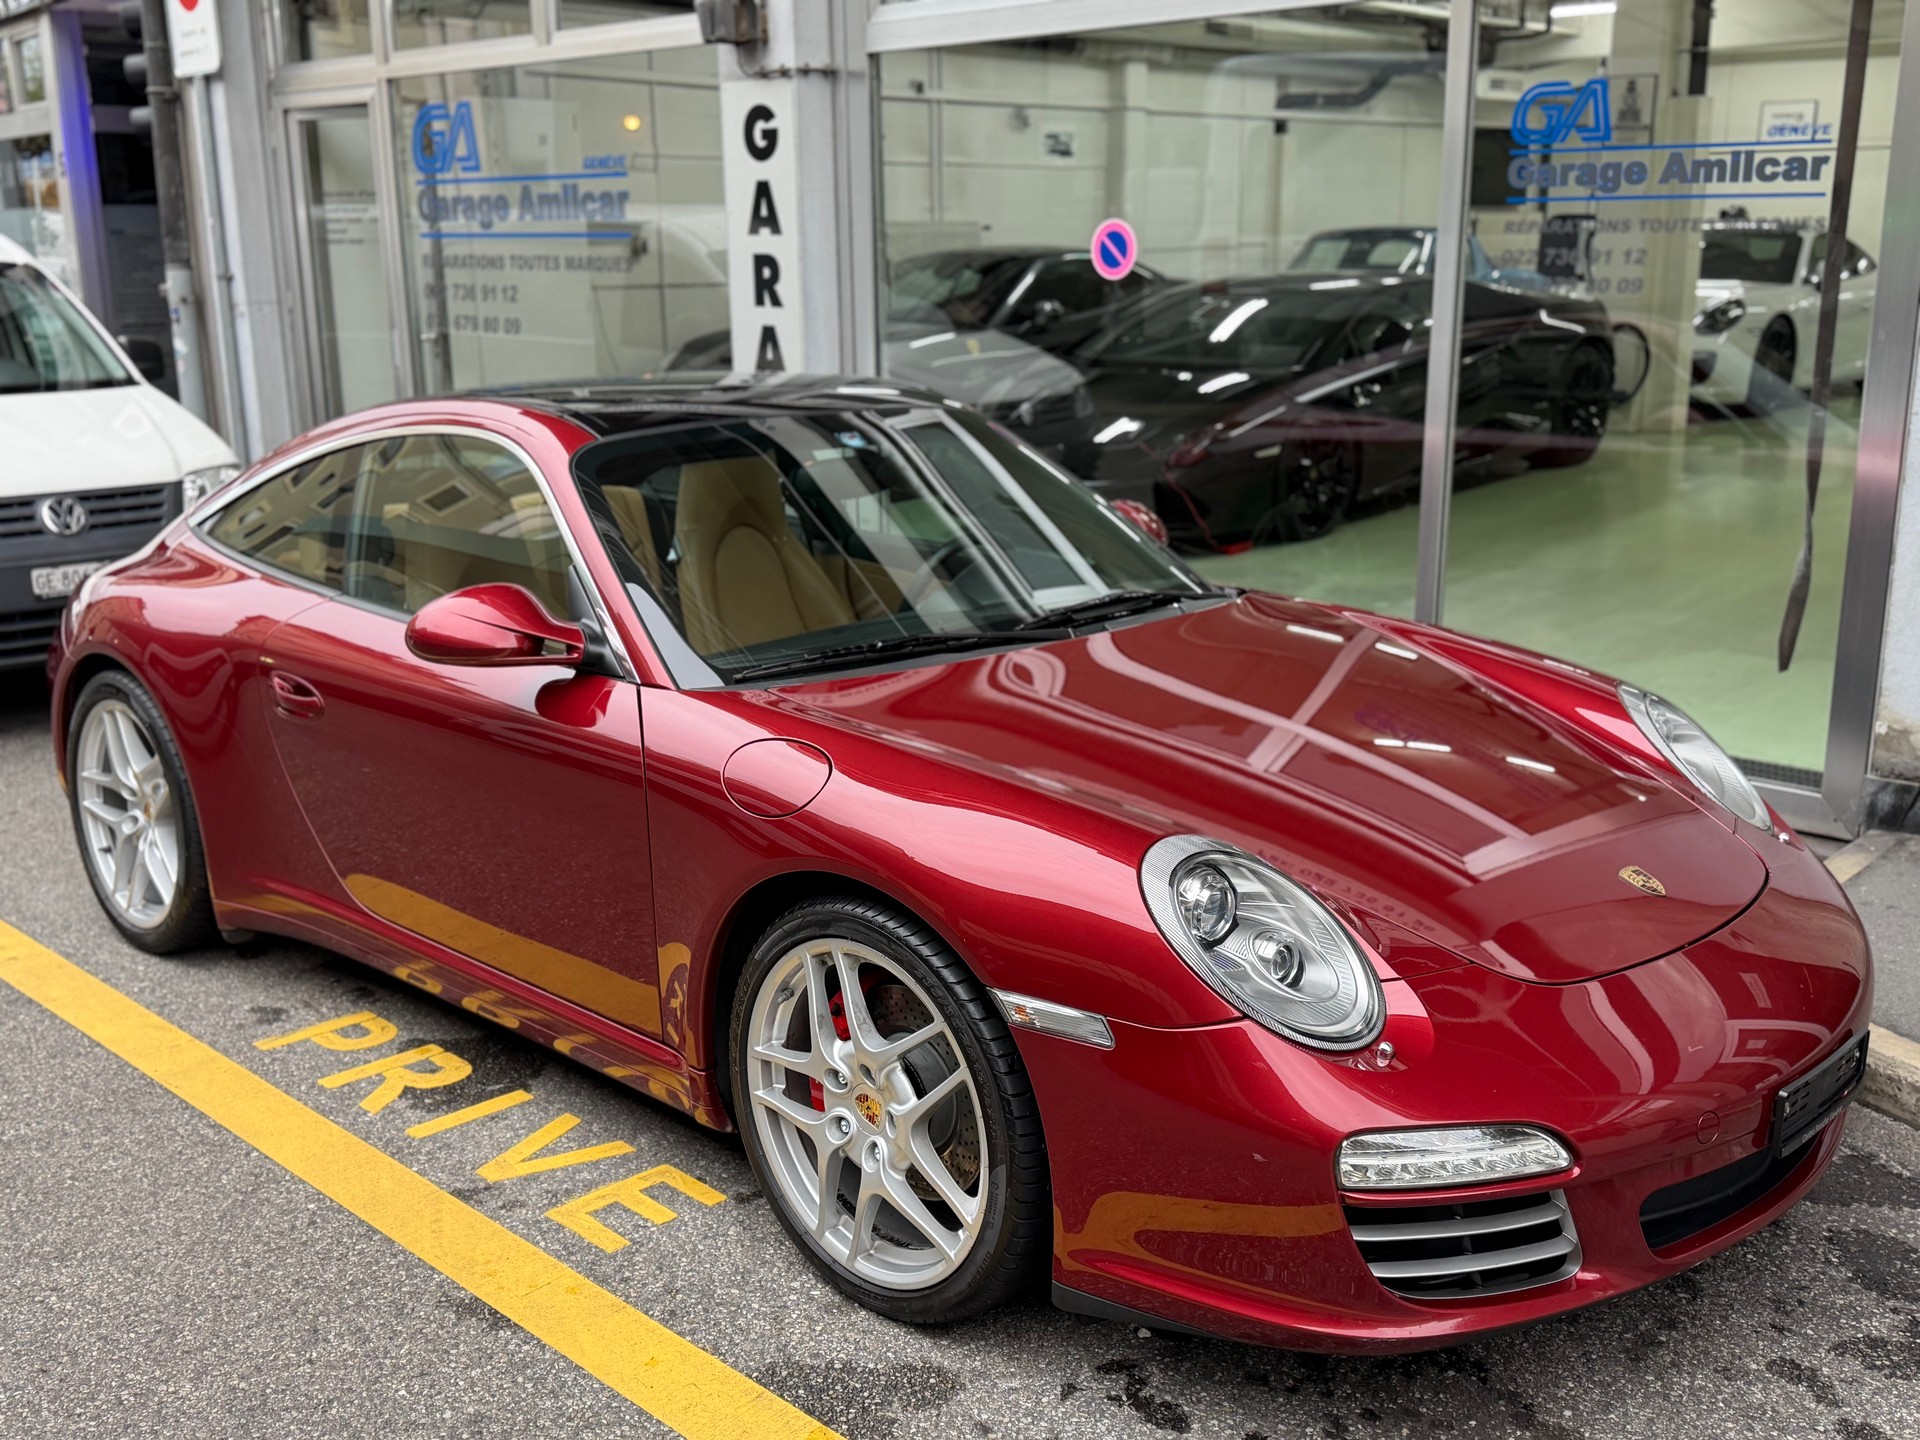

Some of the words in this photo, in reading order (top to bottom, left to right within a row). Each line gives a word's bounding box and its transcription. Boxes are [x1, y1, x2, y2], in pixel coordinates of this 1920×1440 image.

[1507, 156, 1649, 193] Garage
[1659, 150, 1831, 184] Amilcar
[418, 188, 510, 230] Garage
[518, 184, 630, 222] Amilcar
[509, 255, 561, 271] TOUTES
[564, 256, 634, 273] MARQUES
[1622, 248, 1648, 265] 12
[480, 284, 497, 303] 91
[501, 285, 519, 304] 12
[1616, 276, 1643, 294] 09
